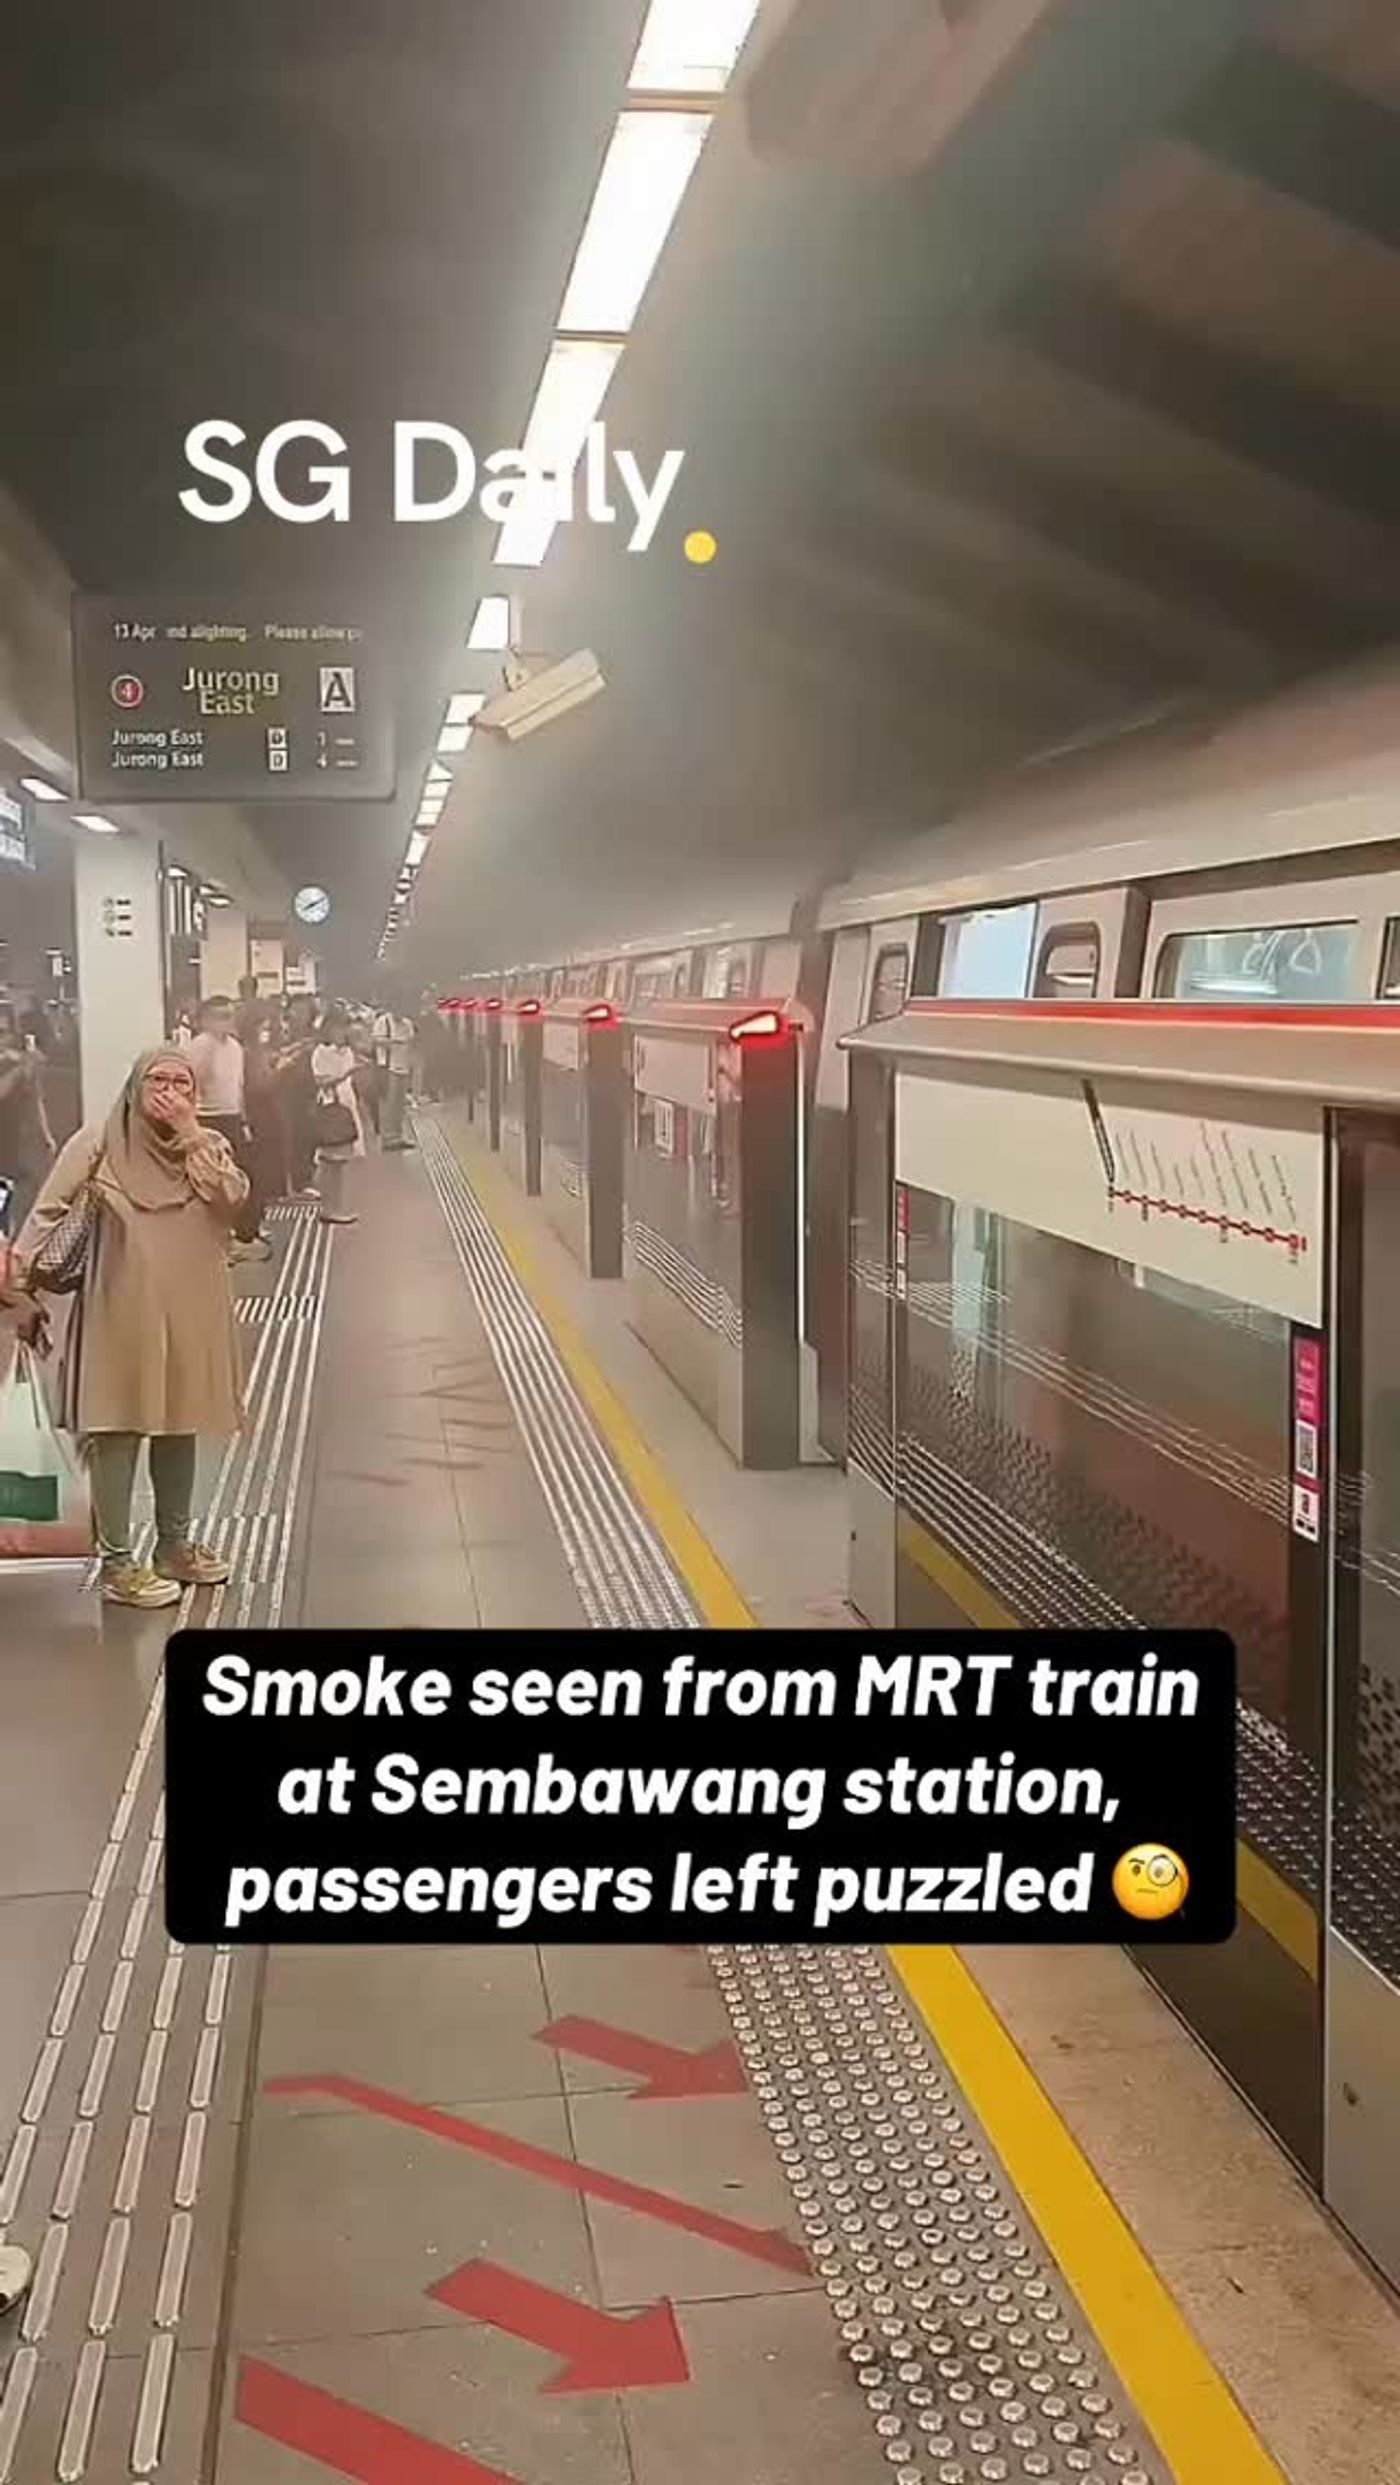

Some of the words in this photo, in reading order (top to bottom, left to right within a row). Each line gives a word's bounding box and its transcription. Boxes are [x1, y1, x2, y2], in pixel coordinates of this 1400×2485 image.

[182, 667, 280, 697] Jurong
[322, 671, 353, 709] A
[200, 690, 255, 715] East
[112, 729, 167, 747] Jurong
[170, 728, 204, 746] East
[112, 751, 168, 770] Jurong
[171, 751, 204, 768] East
